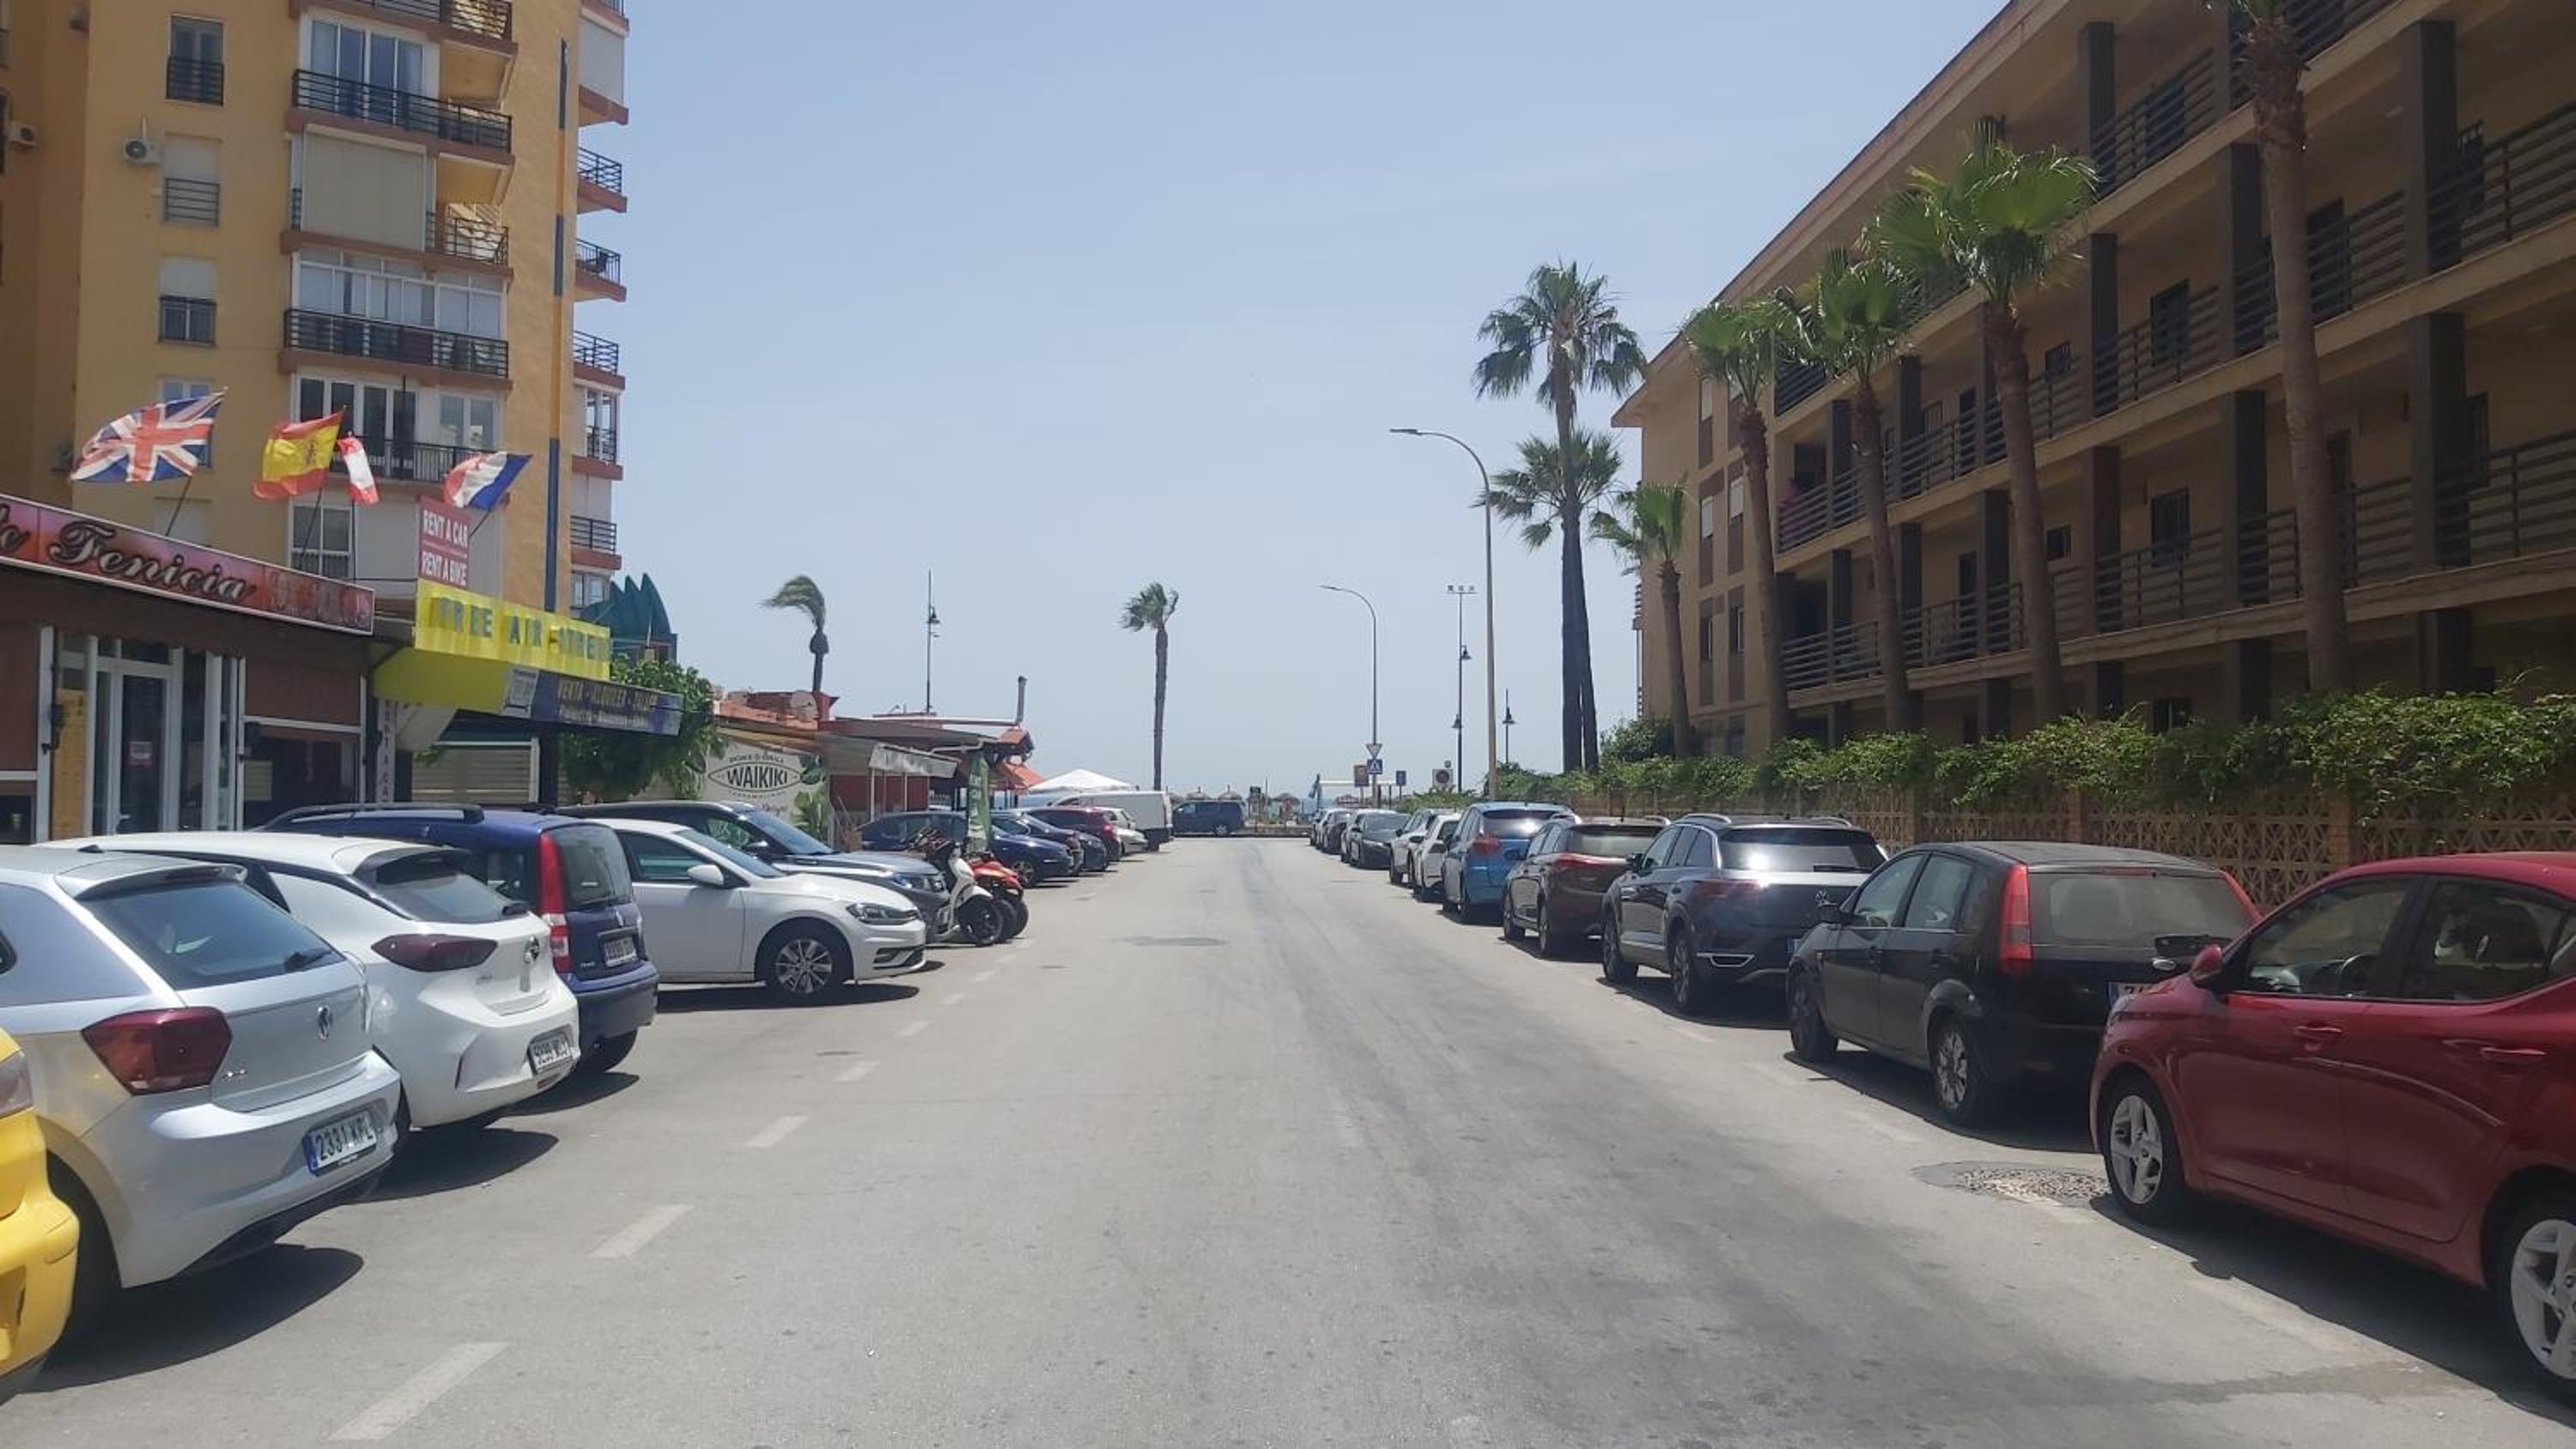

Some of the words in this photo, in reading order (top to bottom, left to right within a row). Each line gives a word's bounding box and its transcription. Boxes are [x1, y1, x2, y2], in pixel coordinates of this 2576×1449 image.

[423, 509, 445, 539] RENT
[446, 518, 453, 543] A
[453, 521, 468, 549] CAR
[46, 519, 256, 603] Fenicia
[422, 550, 442, 578] RENT
[442, 557, 449, 581] A
[449, 559, 467, 587] BIKE
[726, 765, 788, 789] WAIKIKI
[316, 1125, 348, 1161] 2331
